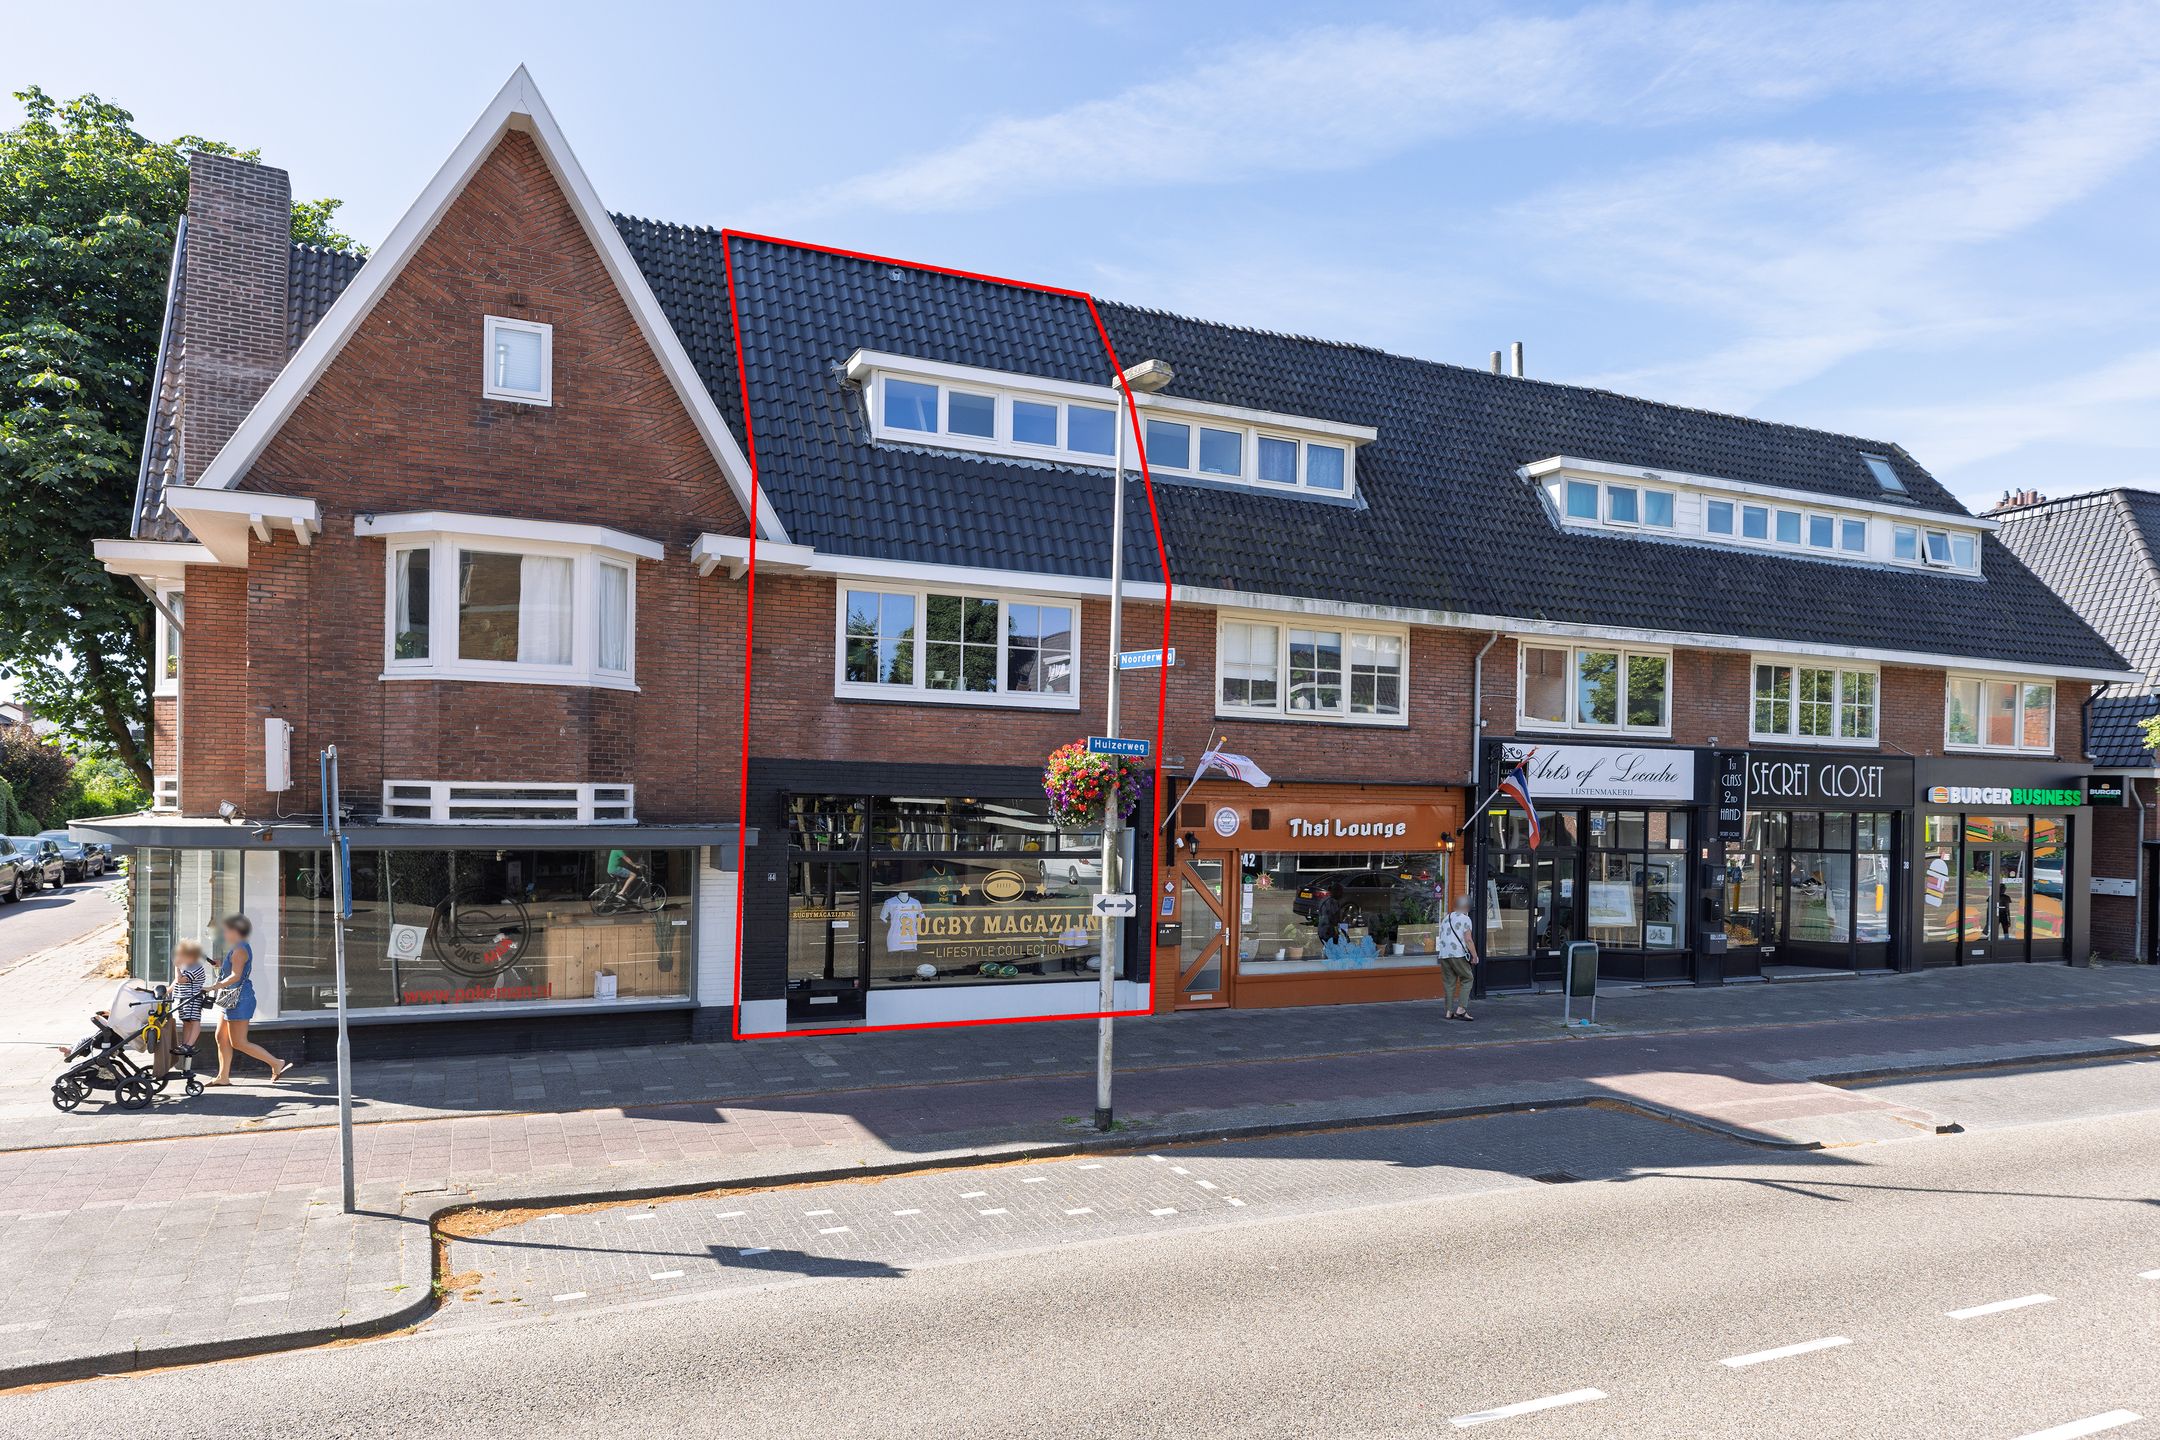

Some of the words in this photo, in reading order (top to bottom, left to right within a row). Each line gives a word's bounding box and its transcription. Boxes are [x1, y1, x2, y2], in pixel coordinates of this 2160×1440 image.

[1121, 653, 1172, 664] Noorderwg
[1094, 740, 1145, 753] Huizerweg
[1528, 750, 1570, 780] Arts
[1576, 758, 1607, 787] of
[1609, 753, 1680, 783] Lecadre
[1721, 774, 1742, 787] CLASS
[1751, 762, 1810, 795] SECRET
[1820, 764, 1884, 798] CLOSET
[1571, 788, 1633, 797] LIJSTENMAKERIJ
[1720, 808, 1741, 820] HAND
[1288, 818, 1330, 838] Thai
[1334, 818, 1406, 838] Lounge
[1242, 853, 1256, 867] 42
[901, 914, 976, 936] RUGBY
[983, 913, 1099, 934] MAGAZIJN
[449, 938, 481, 964] POKE
[936, 945, 995, 958] LIFESTYLE
[998, 944, 1066, 956] COLLECTION
[403, 982, 553, 1003] www.pokeman.nl
